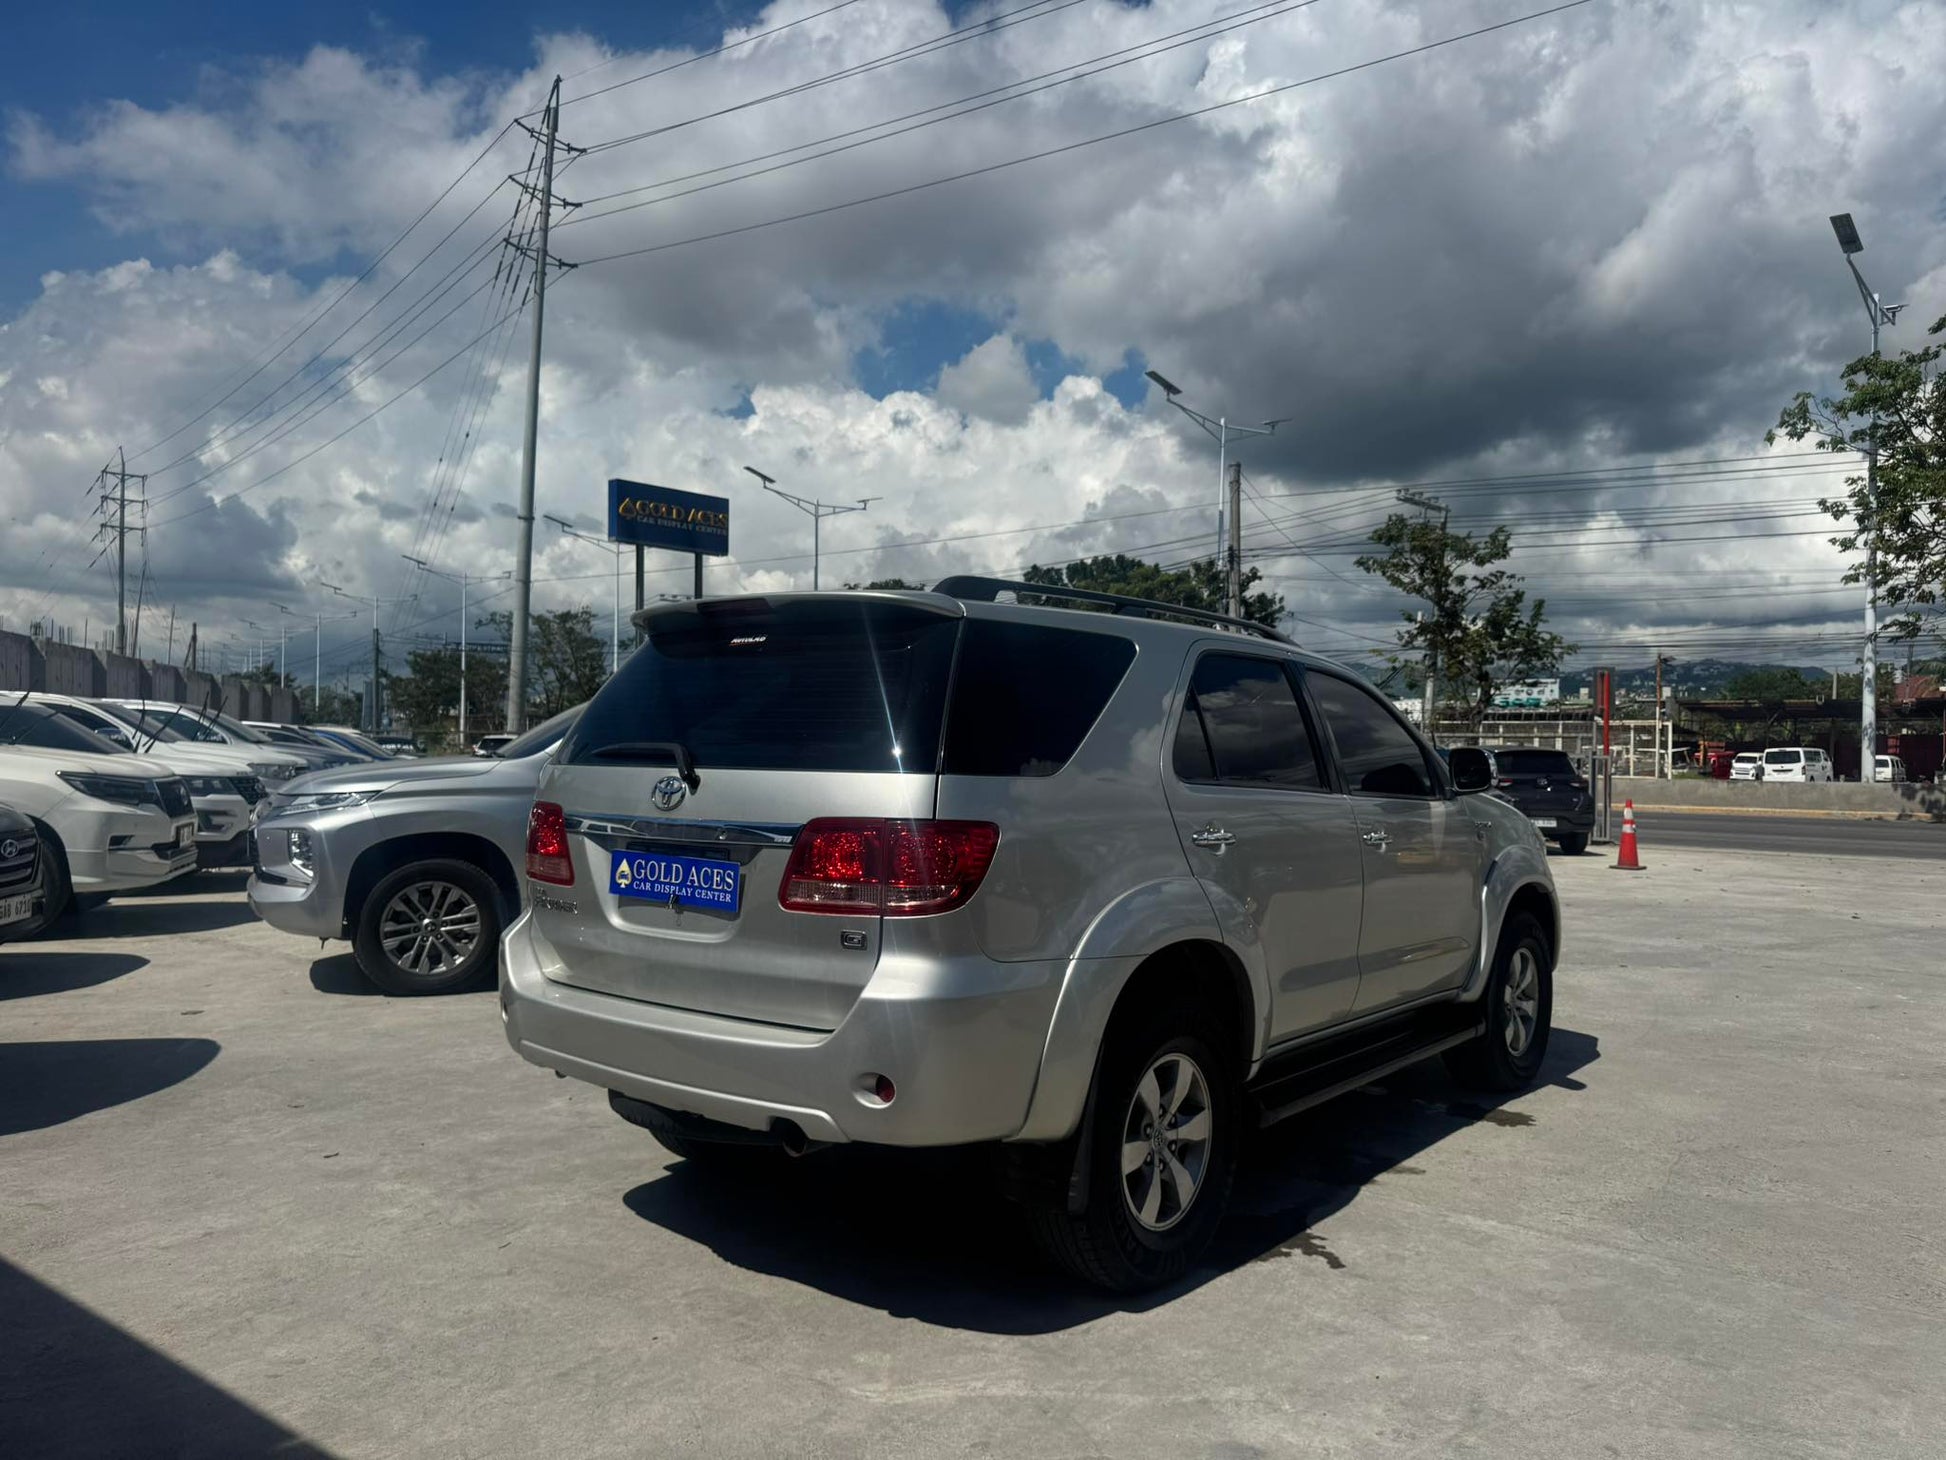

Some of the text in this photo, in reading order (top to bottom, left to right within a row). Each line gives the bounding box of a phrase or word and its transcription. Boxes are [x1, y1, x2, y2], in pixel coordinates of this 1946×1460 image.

[636, 500, 728, 528] GOLD ACES
[633, 859, 734, 891] GOLD ACES
[633, 880, 732, 903] CAR DISPLAY CENTER
